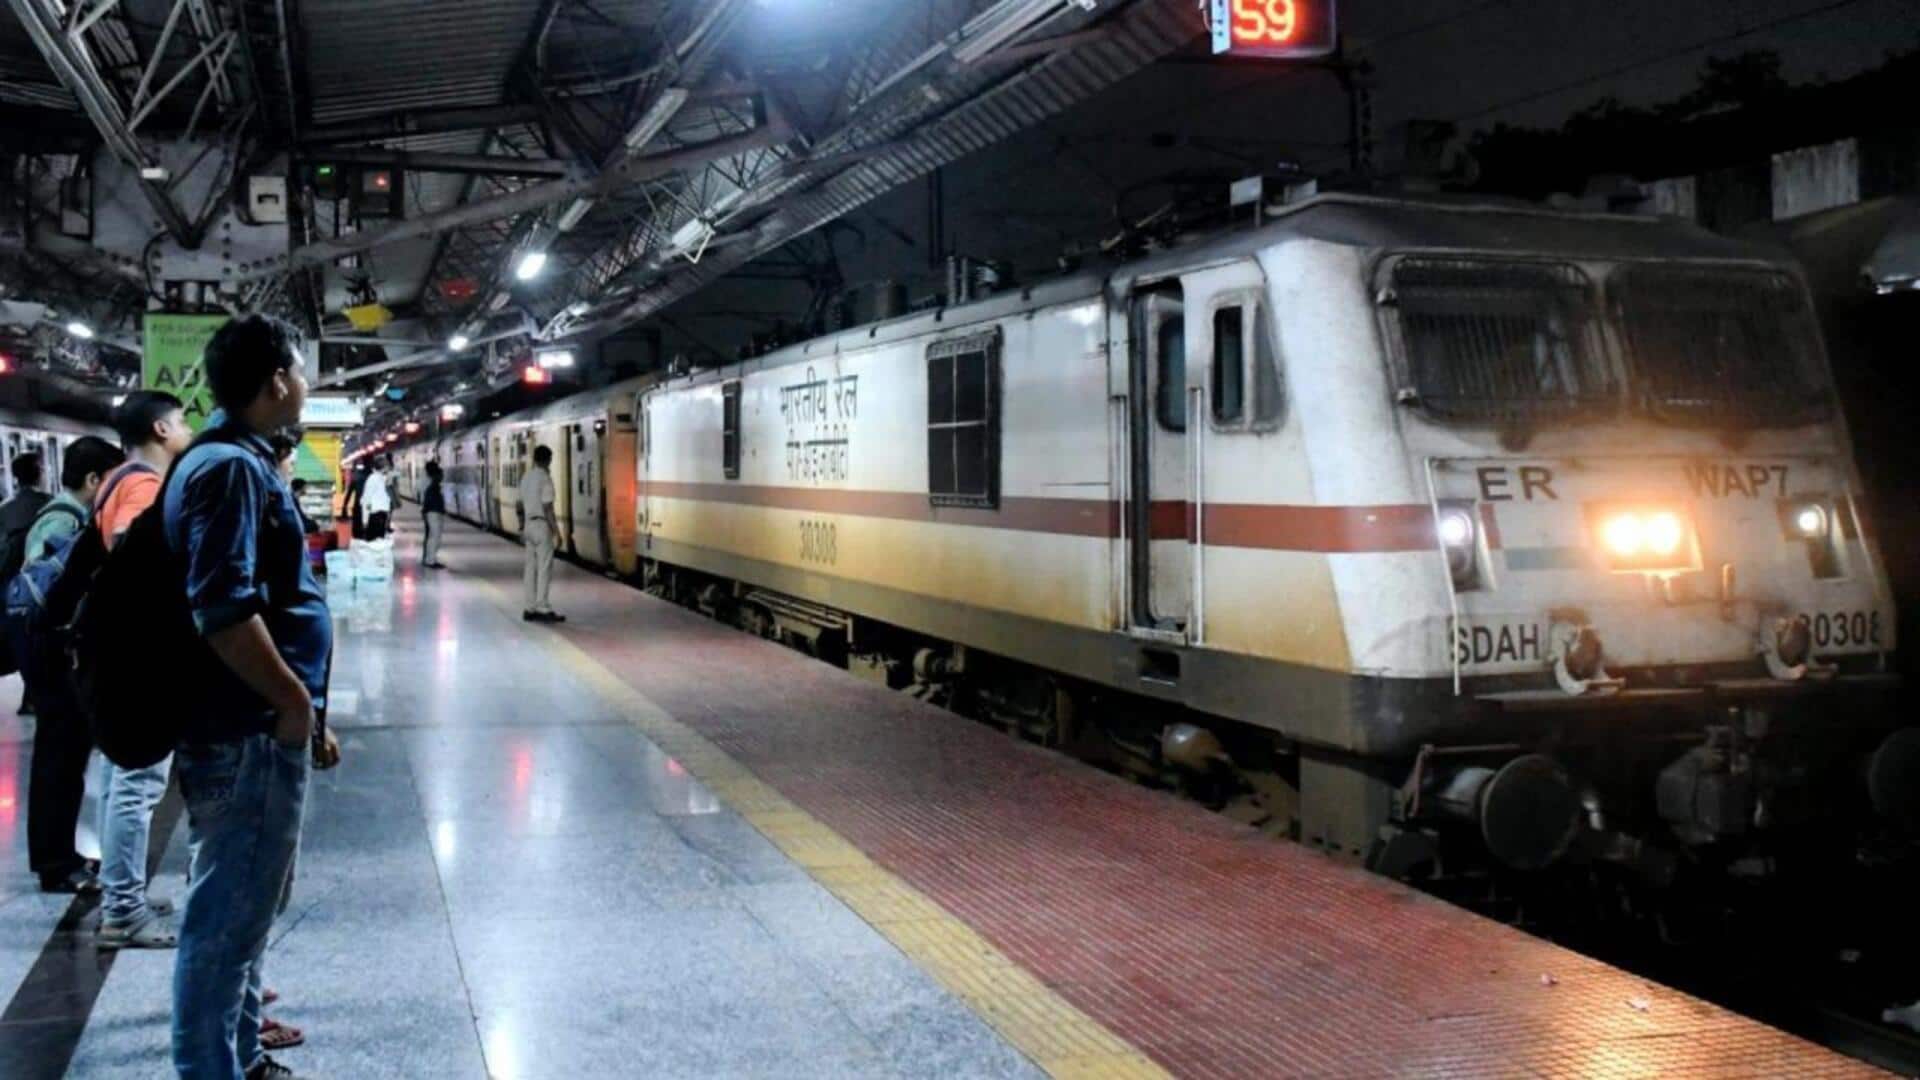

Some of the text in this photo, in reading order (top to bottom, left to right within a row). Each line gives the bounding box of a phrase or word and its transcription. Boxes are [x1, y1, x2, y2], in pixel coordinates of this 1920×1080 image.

[779, 356, 859, 426] भारतीय रेल
[1477, 465, 1557, 501] ER
[1681, 463, 1789, 498] WAP7
[800, 519, 837, 566] 30308
[1449, 622, 1540, 665] SDAH
